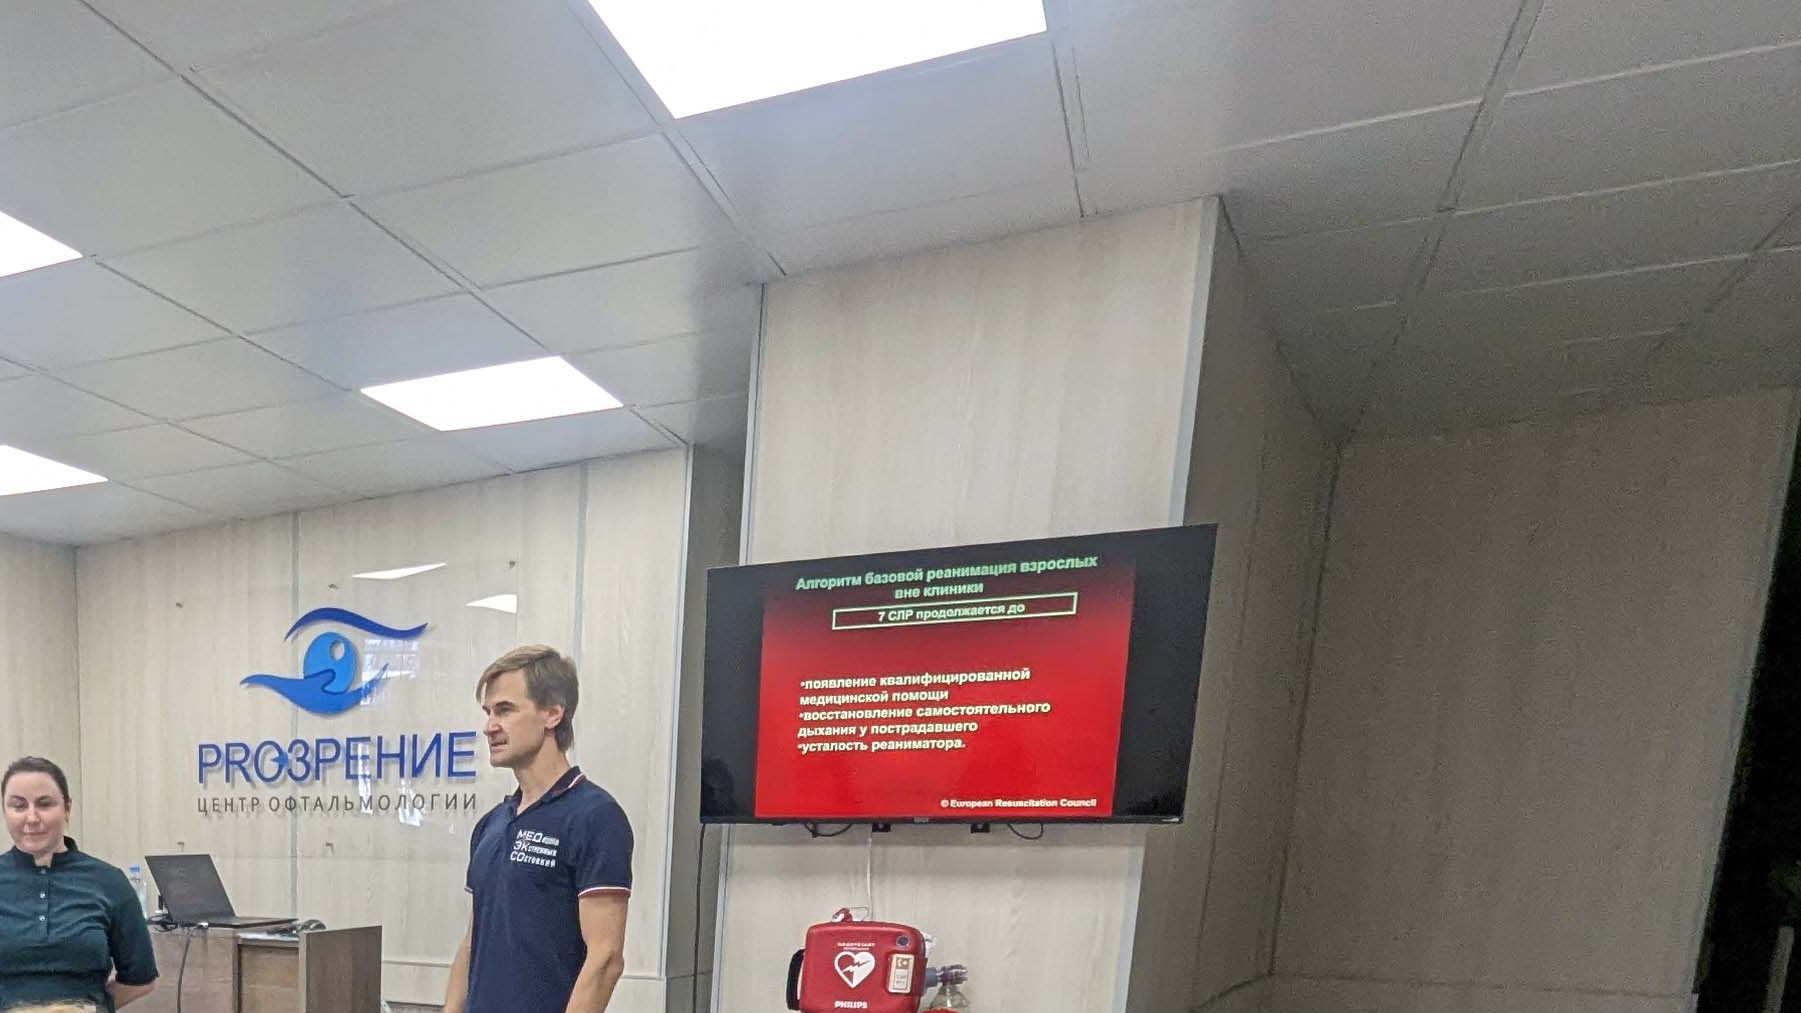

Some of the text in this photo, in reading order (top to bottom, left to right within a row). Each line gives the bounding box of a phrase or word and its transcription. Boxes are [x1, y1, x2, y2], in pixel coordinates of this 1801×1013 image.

[795, 556, 1098, 591] Алгоритм базовой реанимация взрослых
[895, 582, 984, 599] вне клиники
[878, 603, 1025, 622] 7 СЛР продолжается до
[805, 668, 1031, 690] появление квалифицированной
[799, 690, 949, 706] медицинской помощи
[804, 702, 1051, 720] восстановление самостоятельного
[798, 721, 978, 738] дыхания у пострадавшего
[802, 738, 966, 755] усталость реаниматора.
[198, 793, 478, 815] ЦЕНТР ОФТАЛЬМОЛОГИИ
[950, 799, 993, 809] European
[995, 798, 1058, 808] Resuscitation
[1060, 798, 1097, 808] Council
[834, 1000, 868, 1009] PHILIPS
